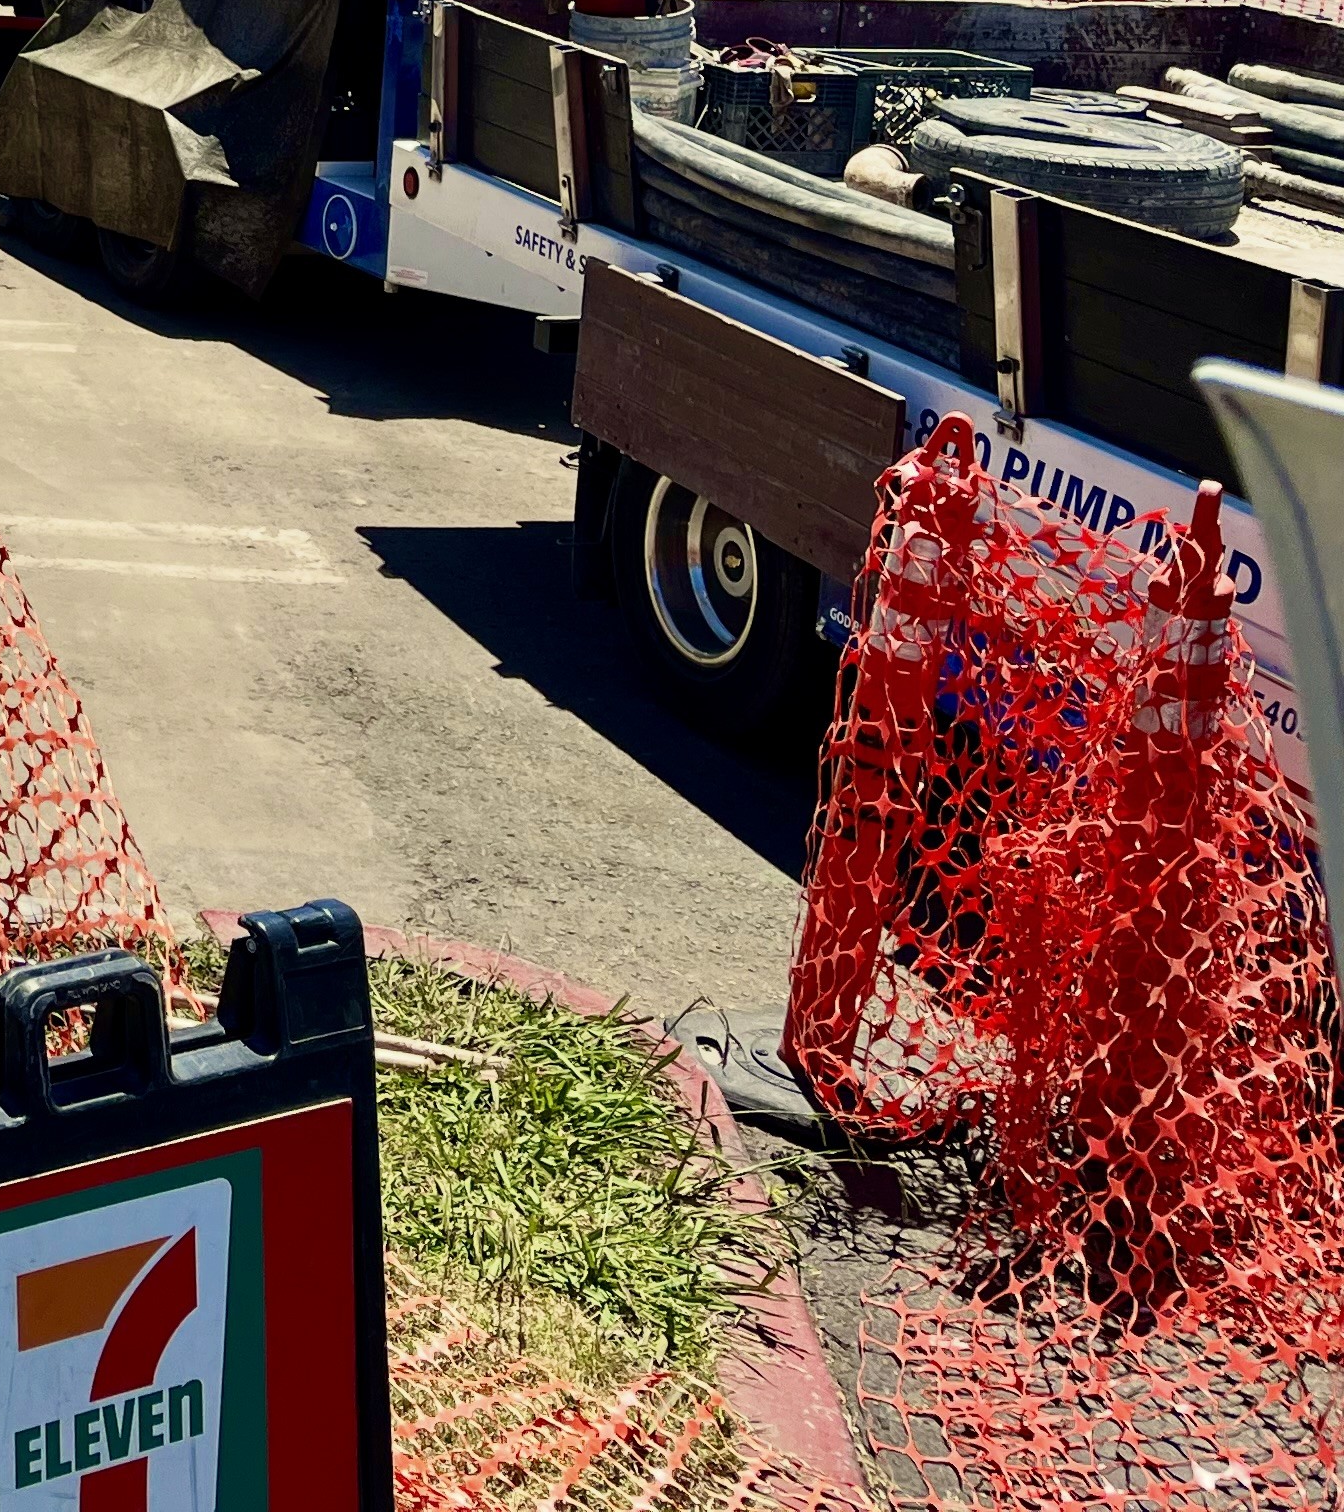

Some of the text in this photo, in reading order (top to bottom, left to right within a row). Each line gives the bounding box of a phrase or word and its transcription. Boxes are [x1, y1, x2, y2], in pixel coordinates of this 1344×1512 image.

[515, 225, 563, 264] SAFETY
[566, 248, 576, 271] &
[829, 607, 852, 630] GOD
[16, 1225, 198, 1512] 7
